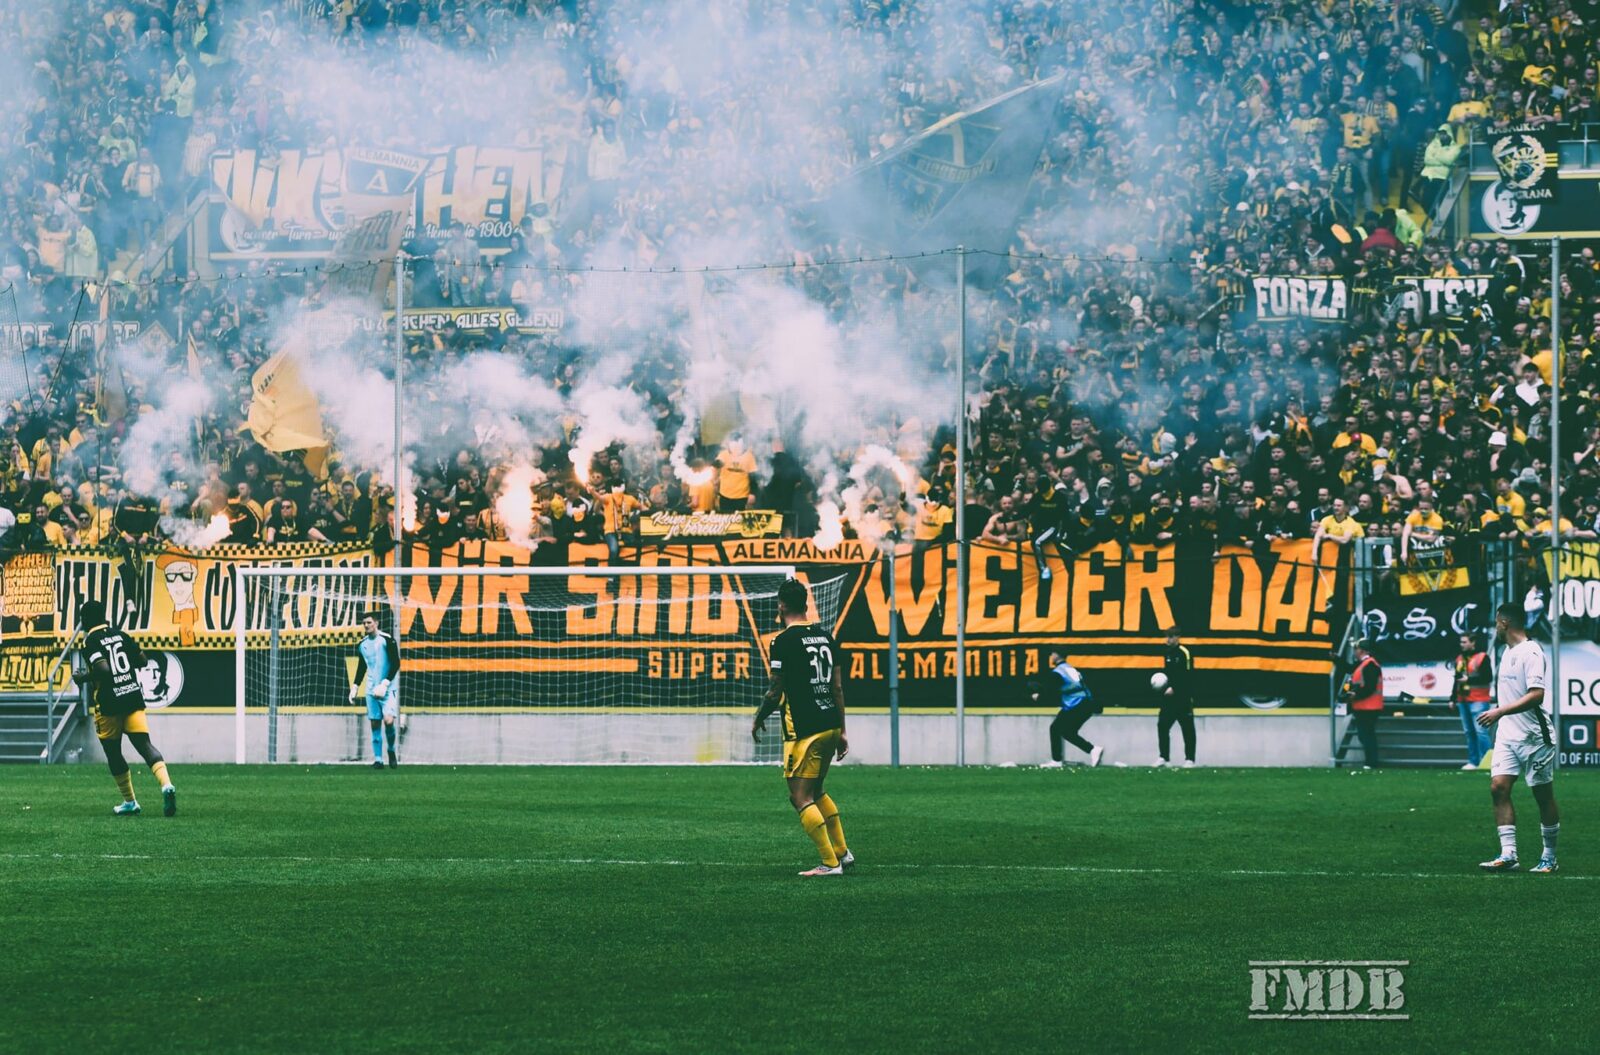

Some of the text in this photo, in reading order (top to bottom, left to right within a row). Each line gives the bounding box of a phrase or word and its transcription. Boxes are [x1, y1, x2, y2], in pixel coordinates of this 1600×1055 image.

[1253, 277, 1347, 319] FORZA
[455, 313, 501, 329] ALLES
[733, 541, 867, 562] ALEMANNIA
[204, 555, 370, 631] CONNECTION
[864, 537, 1177, 636] WIEDER
[1209, 537, 1340, 636] DA!
[105, 642, 130, 675] 16
[648, 648, 1039, 680] SUPER ALEMANNIA
[806, 645, 833, 684] 30
[1532, 761, 1545, 771] 25
[1569, 752, 1582, 765] OF
